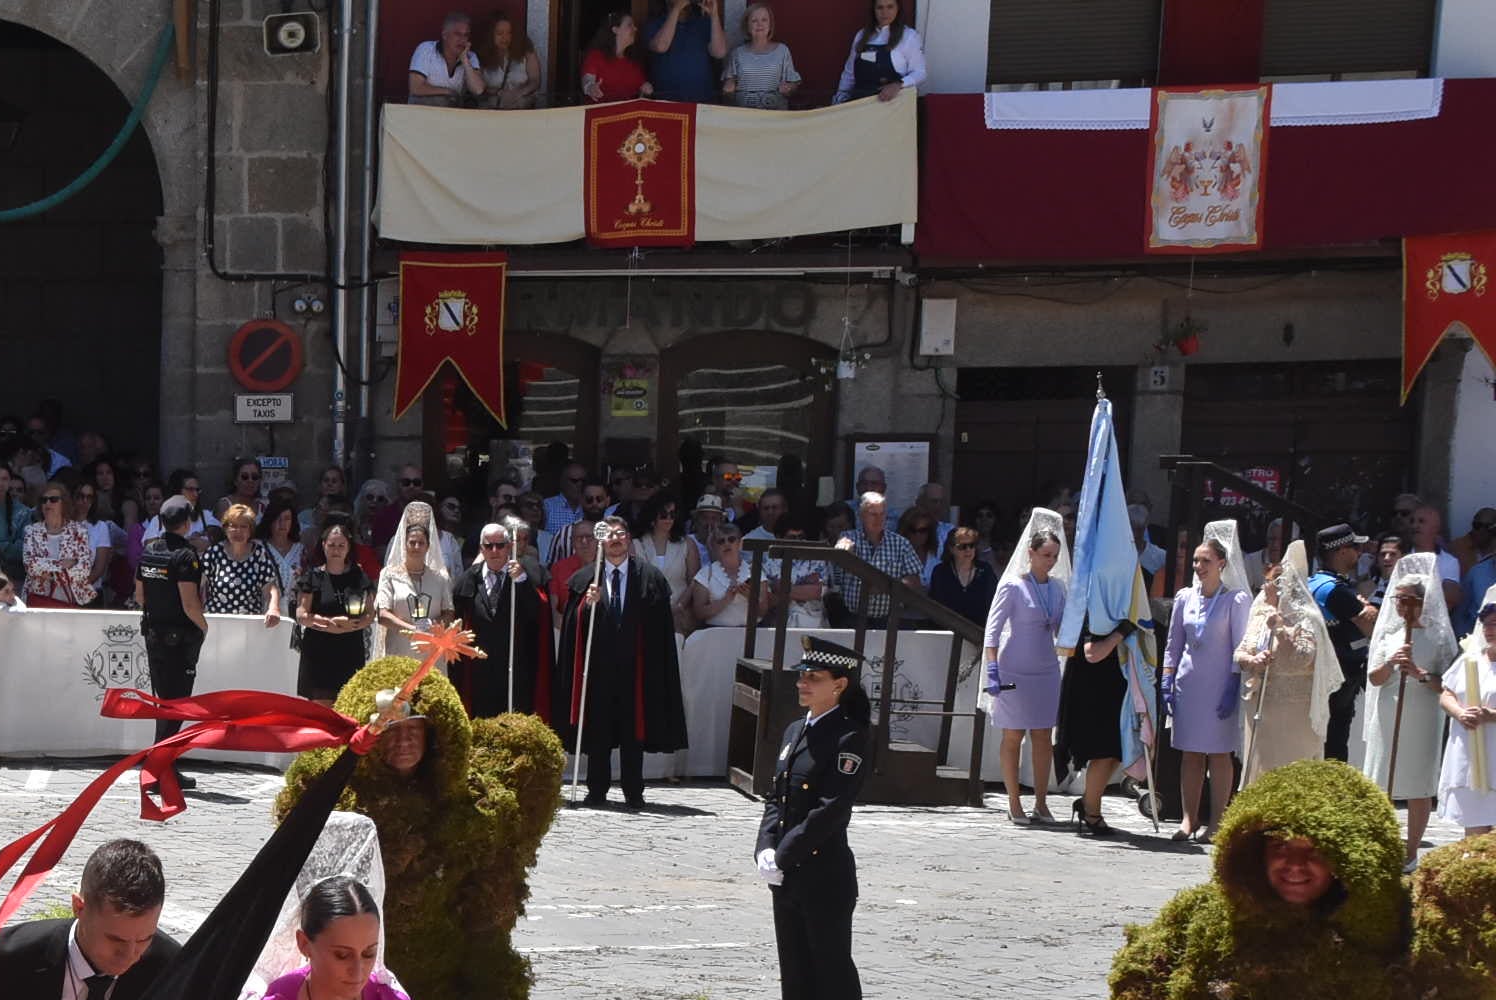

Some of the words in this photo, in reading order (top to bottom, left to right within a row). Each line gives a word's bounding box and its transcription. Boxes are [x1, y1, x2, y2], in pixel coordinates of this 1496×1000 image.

[1153, 370, 1166, 386] 5
[246, 398, 282, 407] EXCEPTO
[253, 409, 276, 418] TAXIS
